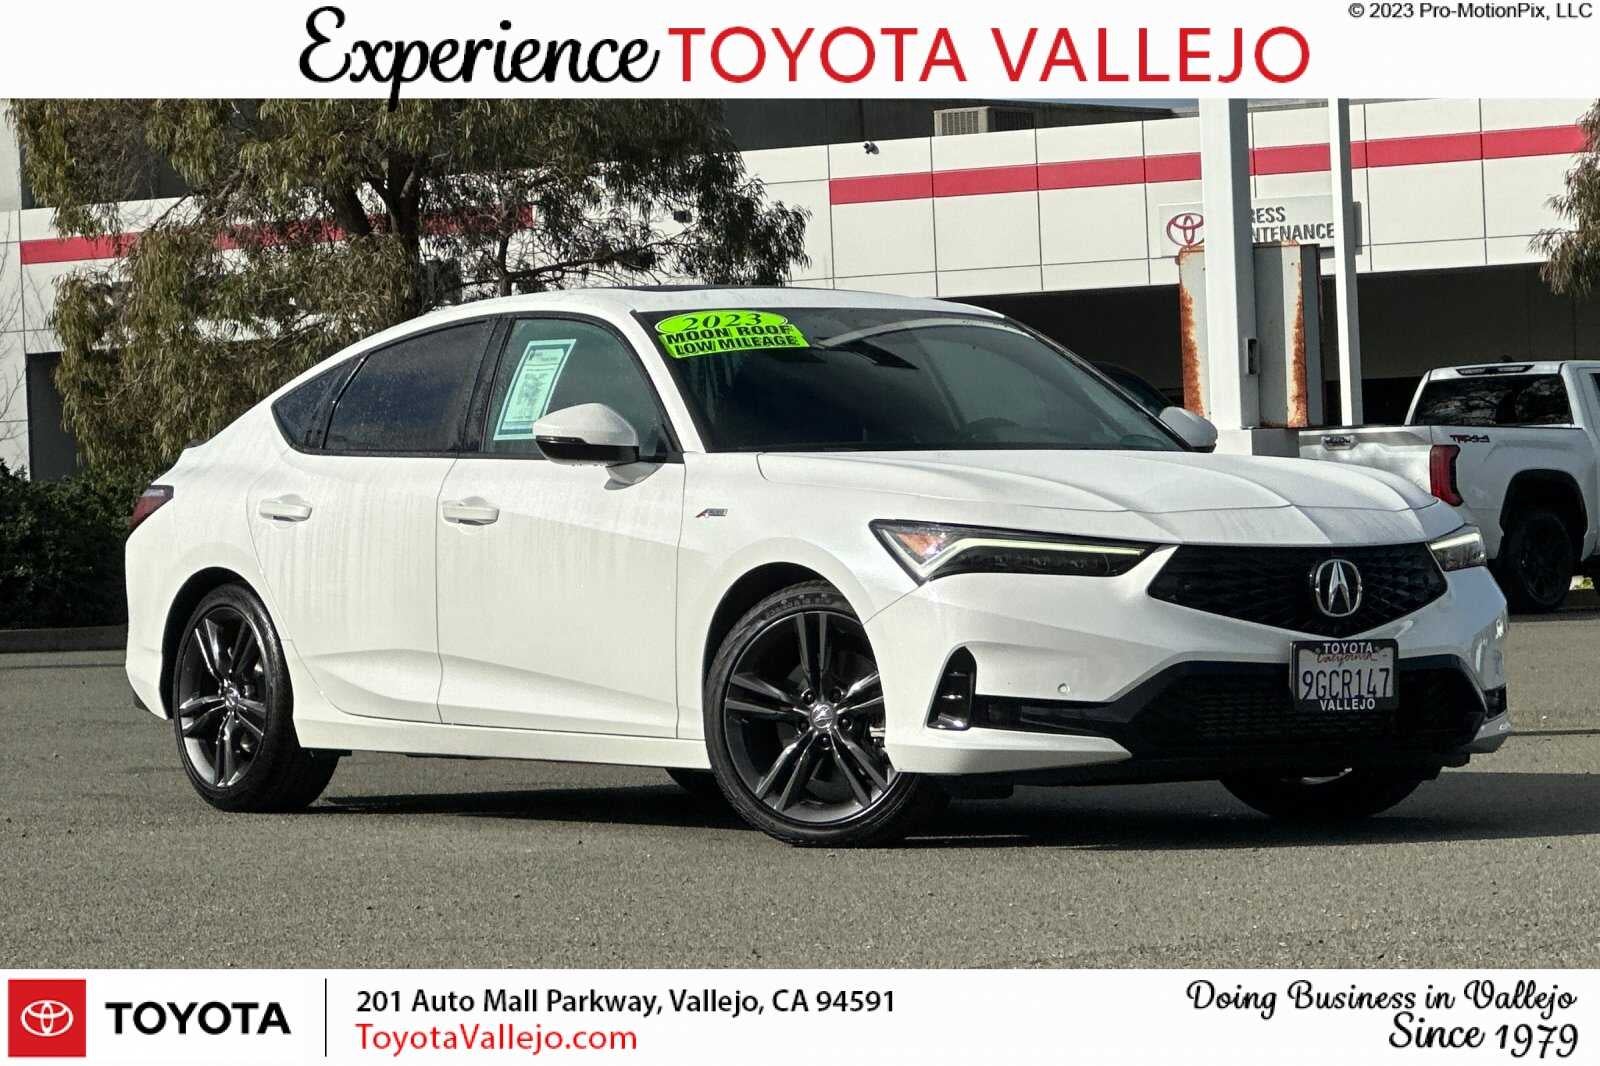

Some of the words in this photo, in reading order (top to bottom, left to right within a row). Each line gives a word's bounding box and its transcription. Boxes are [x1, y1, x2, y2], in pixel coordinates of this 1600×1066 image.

[1251, 223, 1335, 243] NTENANCE
[682, 313, 762, 331] 2023
[666, 327, 730, 345] MOON
[739, 325, 792, 337] ROOF
[675, 340, 713, 356] LOW
[720, 336, 798, 350] MILEAGE
[1323, 642, 1374, 654] TOYOTA
[1302, 668, 1390, 701] 9GCR147
[1320, 698, 1376, 711] VALLEJO
